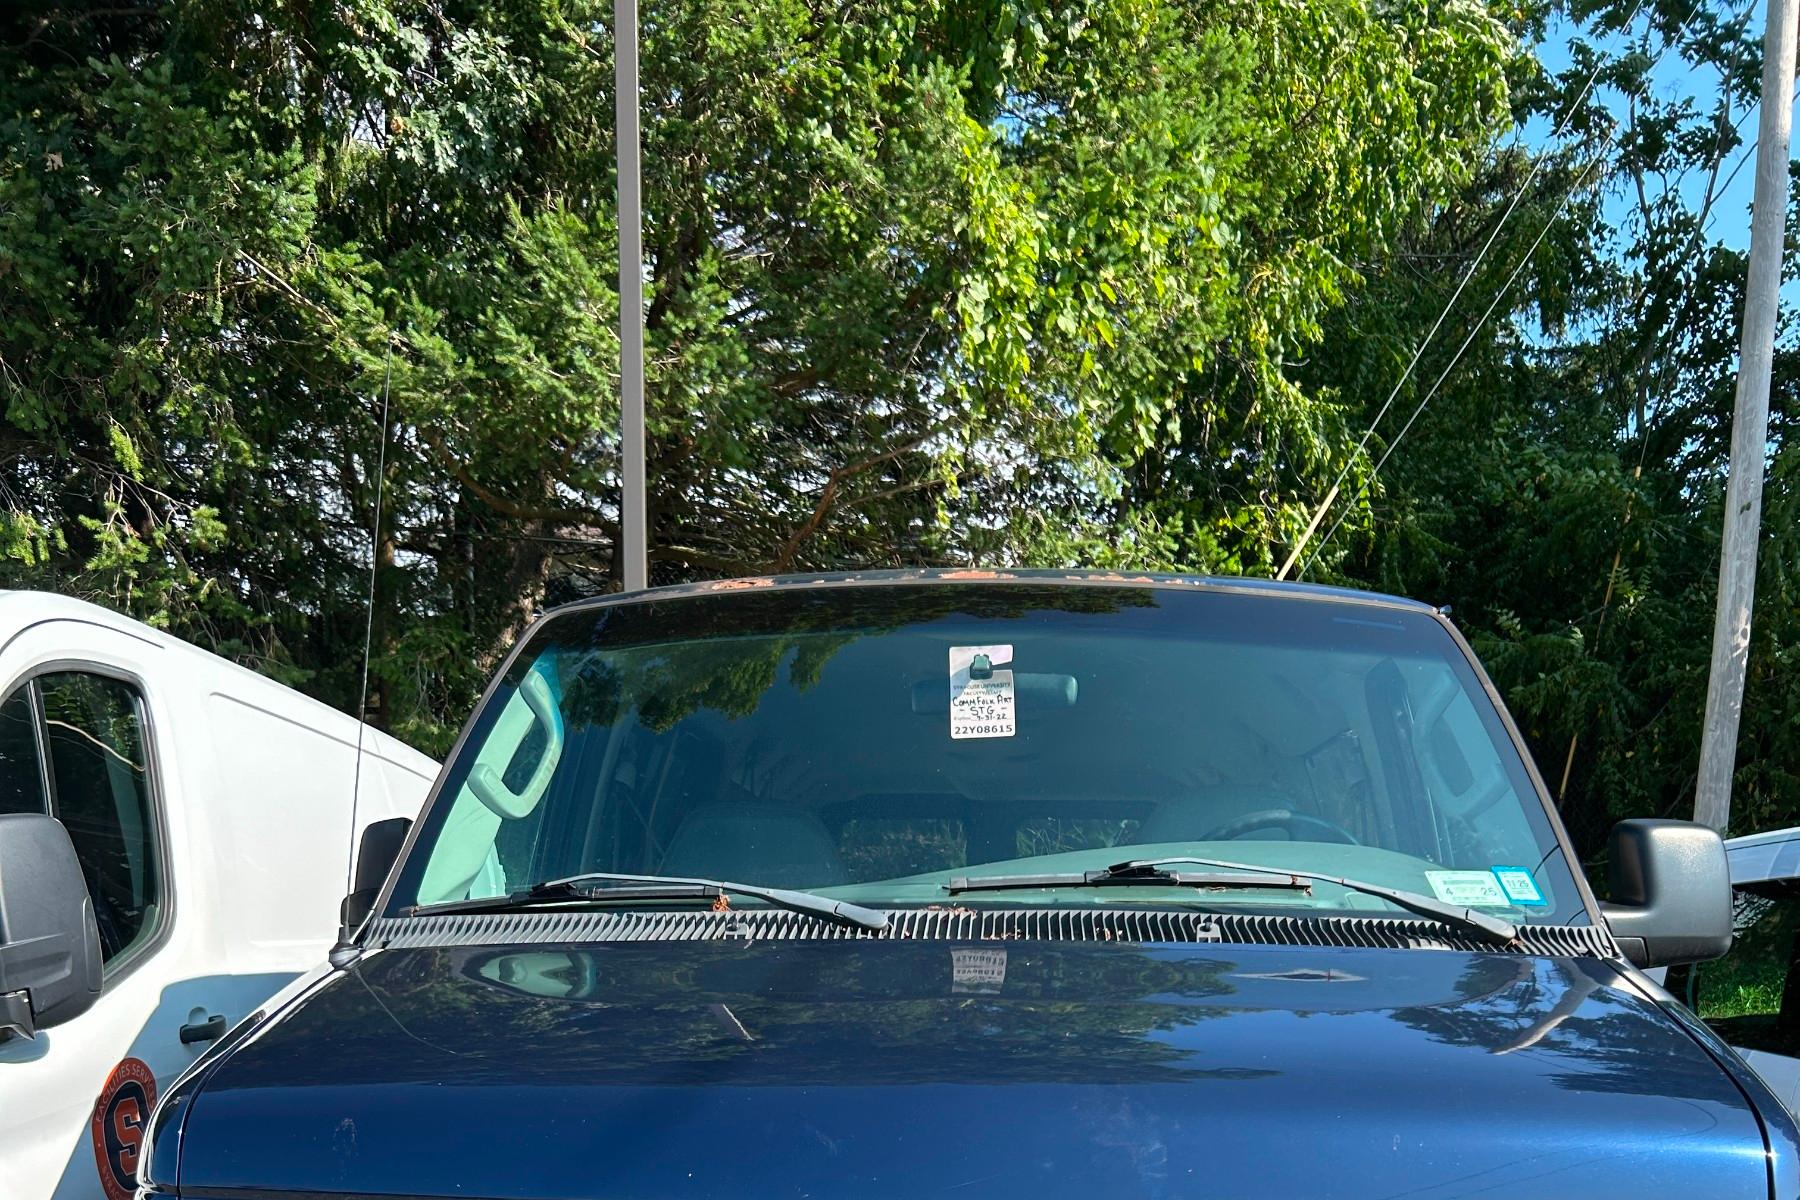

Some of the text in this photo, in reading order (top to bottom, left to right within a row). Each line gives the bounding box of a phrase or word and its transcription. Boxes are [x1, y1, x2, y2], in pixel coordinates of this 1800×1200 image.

[954, 724, 1013, 735] 22Y08615
[96, 1063, 155, 1122] FACILITIES SERVICES
[114, 1096, 144, 1176] S
